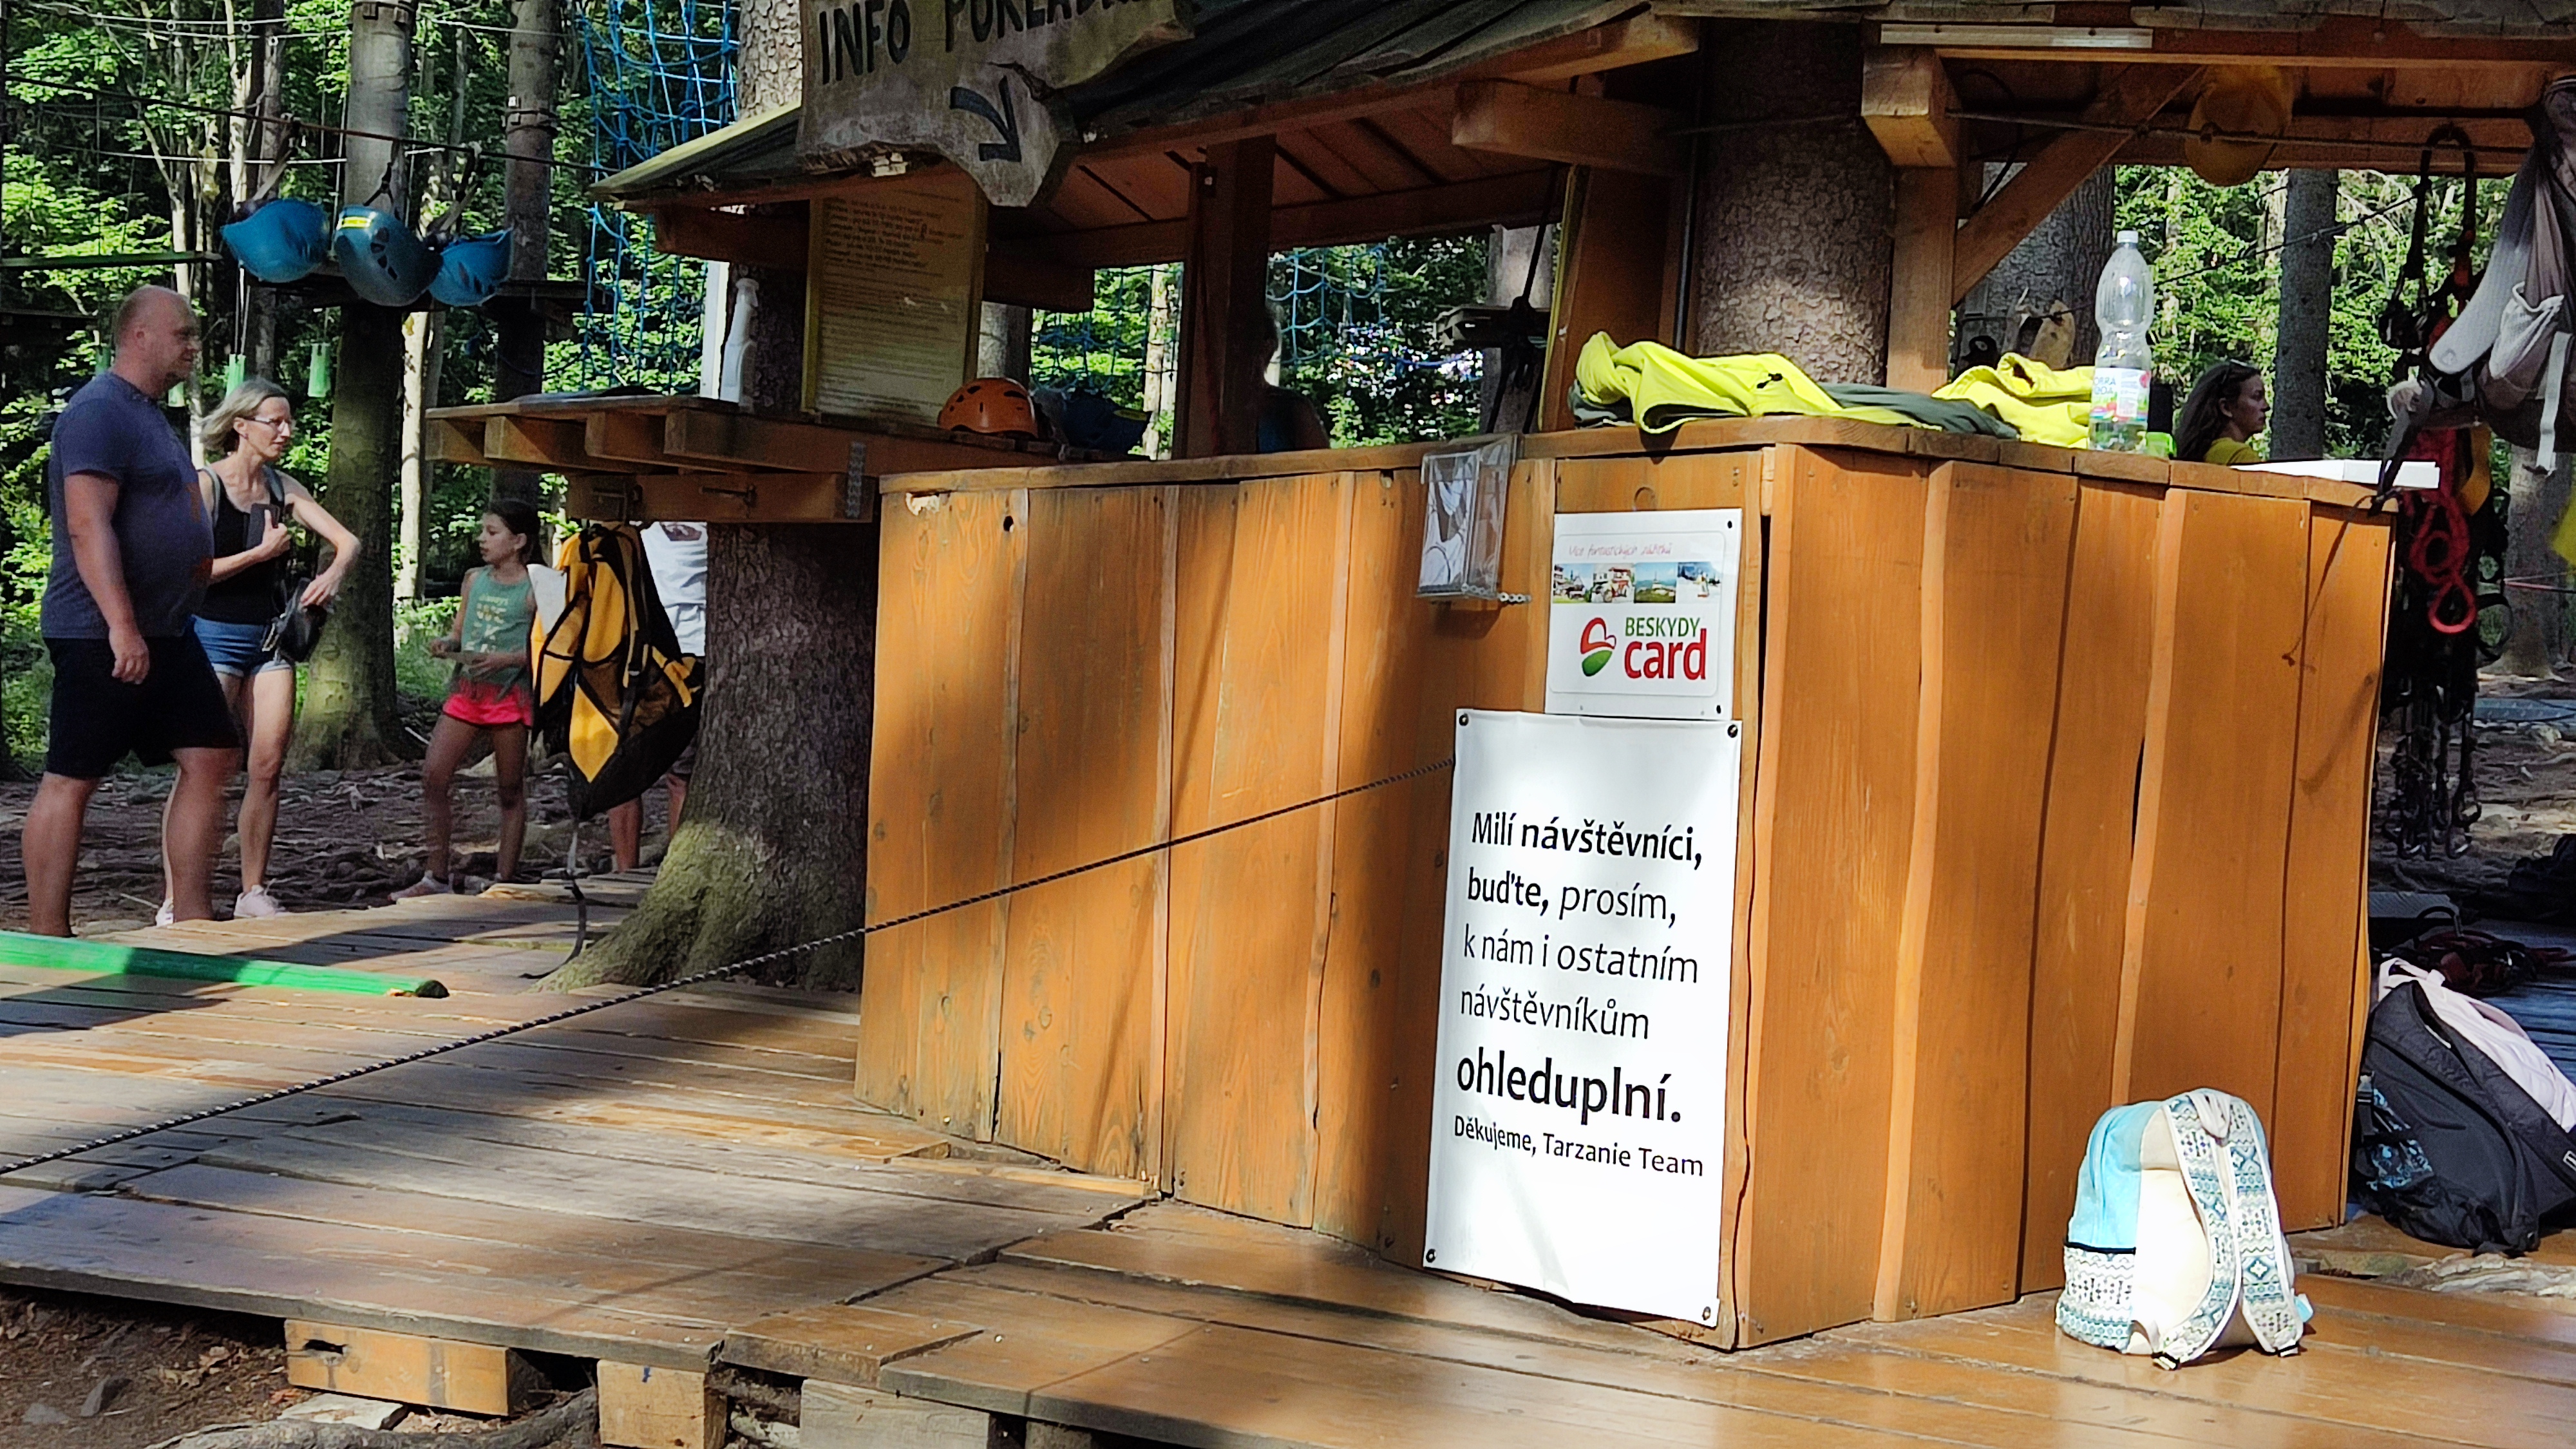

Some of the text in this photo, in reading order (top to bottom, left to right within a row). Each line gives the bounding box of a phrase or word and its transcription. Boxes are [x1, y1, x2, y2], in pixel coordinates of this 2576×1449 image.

[819, 0, 911, 85] INFO
[1624, 627, 1707, 681] card
[1625, 616, 1700, 638] BESKYDY
[1472, 811, 1702, 871] Milí návštěvníci,
[1467, 866, 1676, 929] buďte, prosím,
[1464, 923, 1698, 983] k nám i ostatním
[1461, 983, 1649, 1039] návštěvníkům
[1457, 1046, 1681, 1126] ohleduplní.
[1454, 1115, 1703, 1177] Děkujeme, Tarzanie Team
